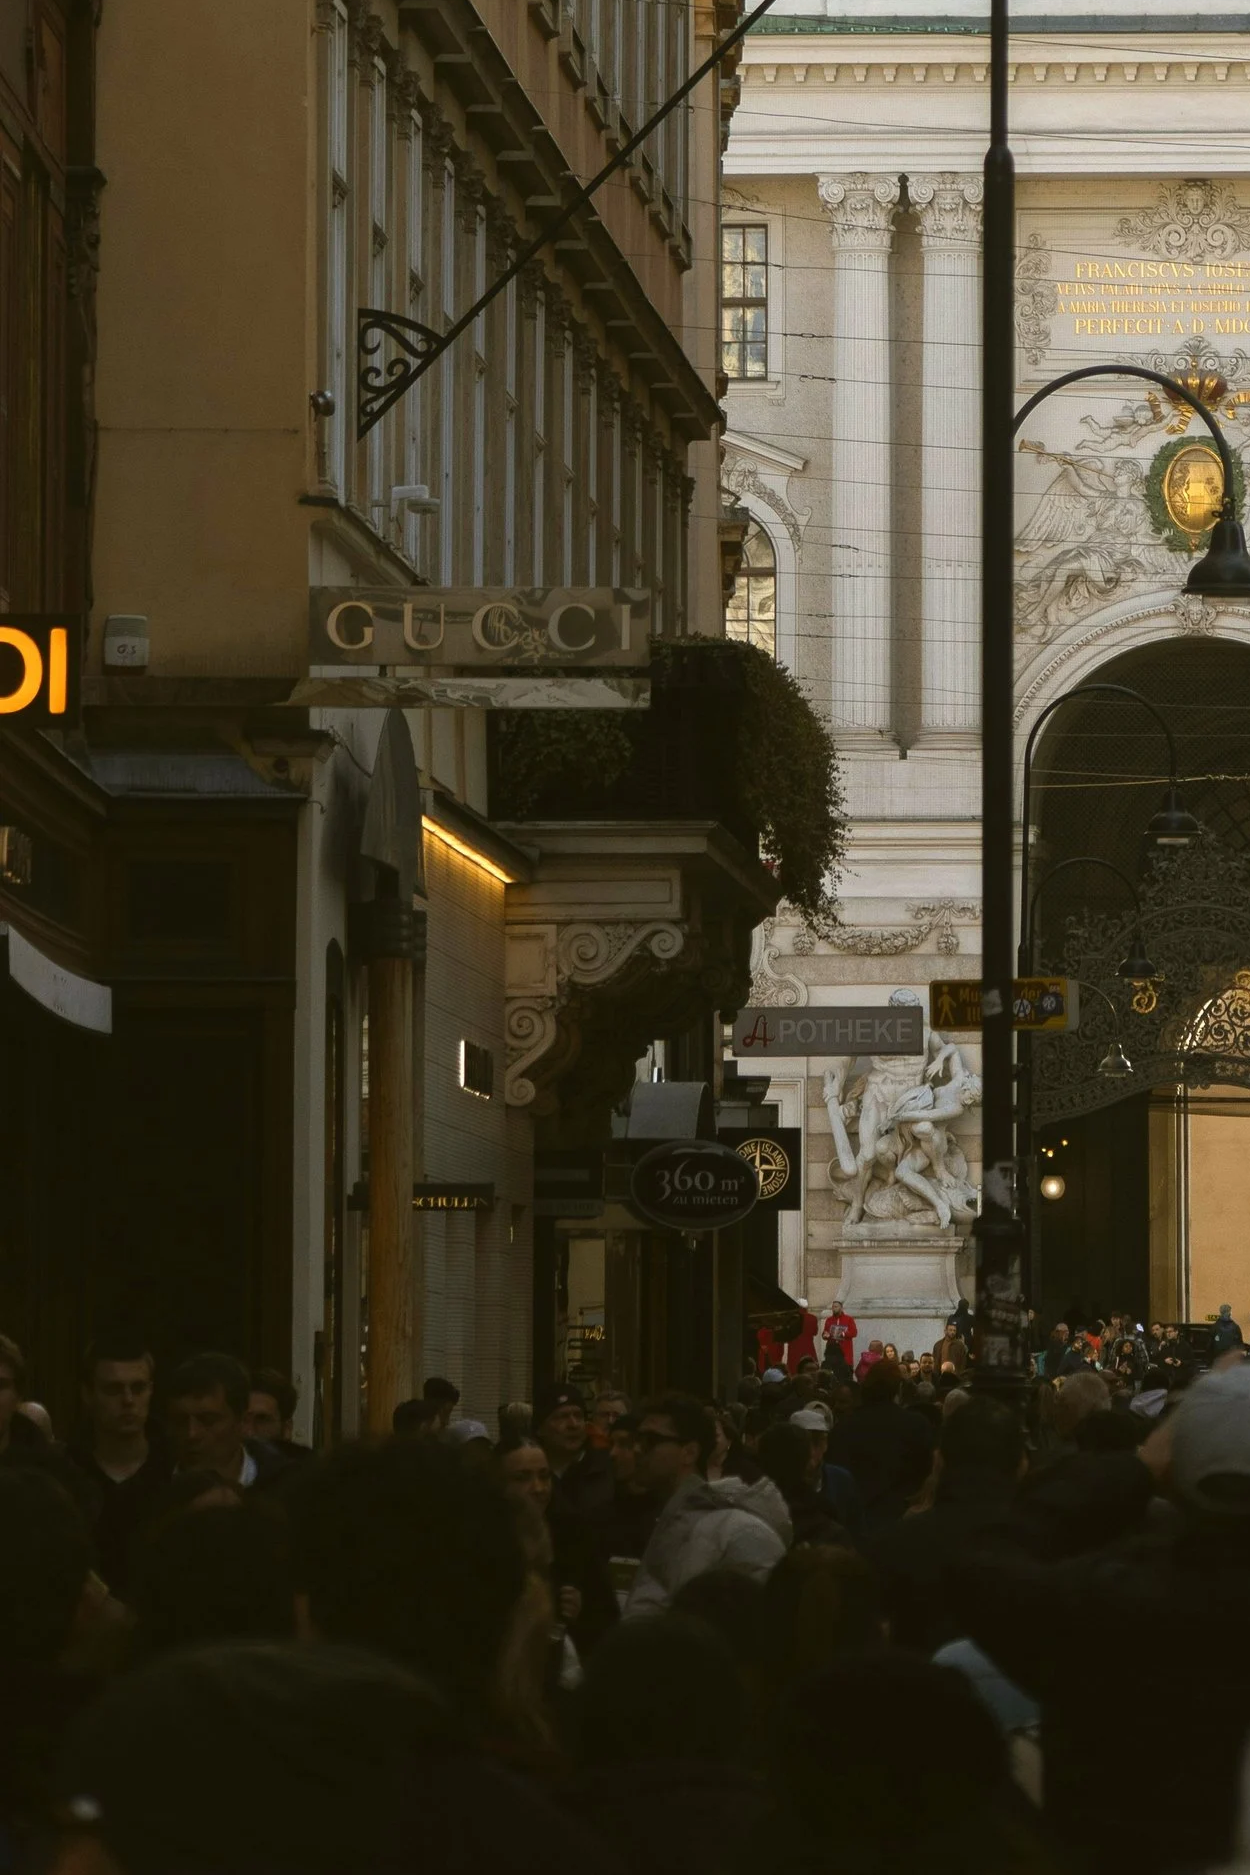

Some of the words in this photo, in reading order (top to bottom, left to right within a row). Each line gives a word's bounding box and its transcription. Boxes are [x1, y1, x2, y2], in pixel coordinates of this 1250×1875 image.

[1075, 262, 1195, 278] FRANCISCVS
[1057, 283, 1095, 295] VETVS
[1150, 283, 1181, 295] OPVS
[1058, 301, 1065, 313] A
[1070, 301, 1106, 313] MARIA
[1111, 301, 1167, 313] THERESIA
[1171, 301, 1184, 313] ET
[1075, 318, 1164, 335] PERFECIT
[1172, 319, 1184, 335] A
[1193, 318, 1205, 335] D
[326, 600, 631, 651] GUCCI
[742, 1014, 913, 1047] APOTHEKE
[655, 1158, 715, 1203] 360
[672, 1195, 689, 1205] zu
[692, 1193, 739, 1205] mieten
